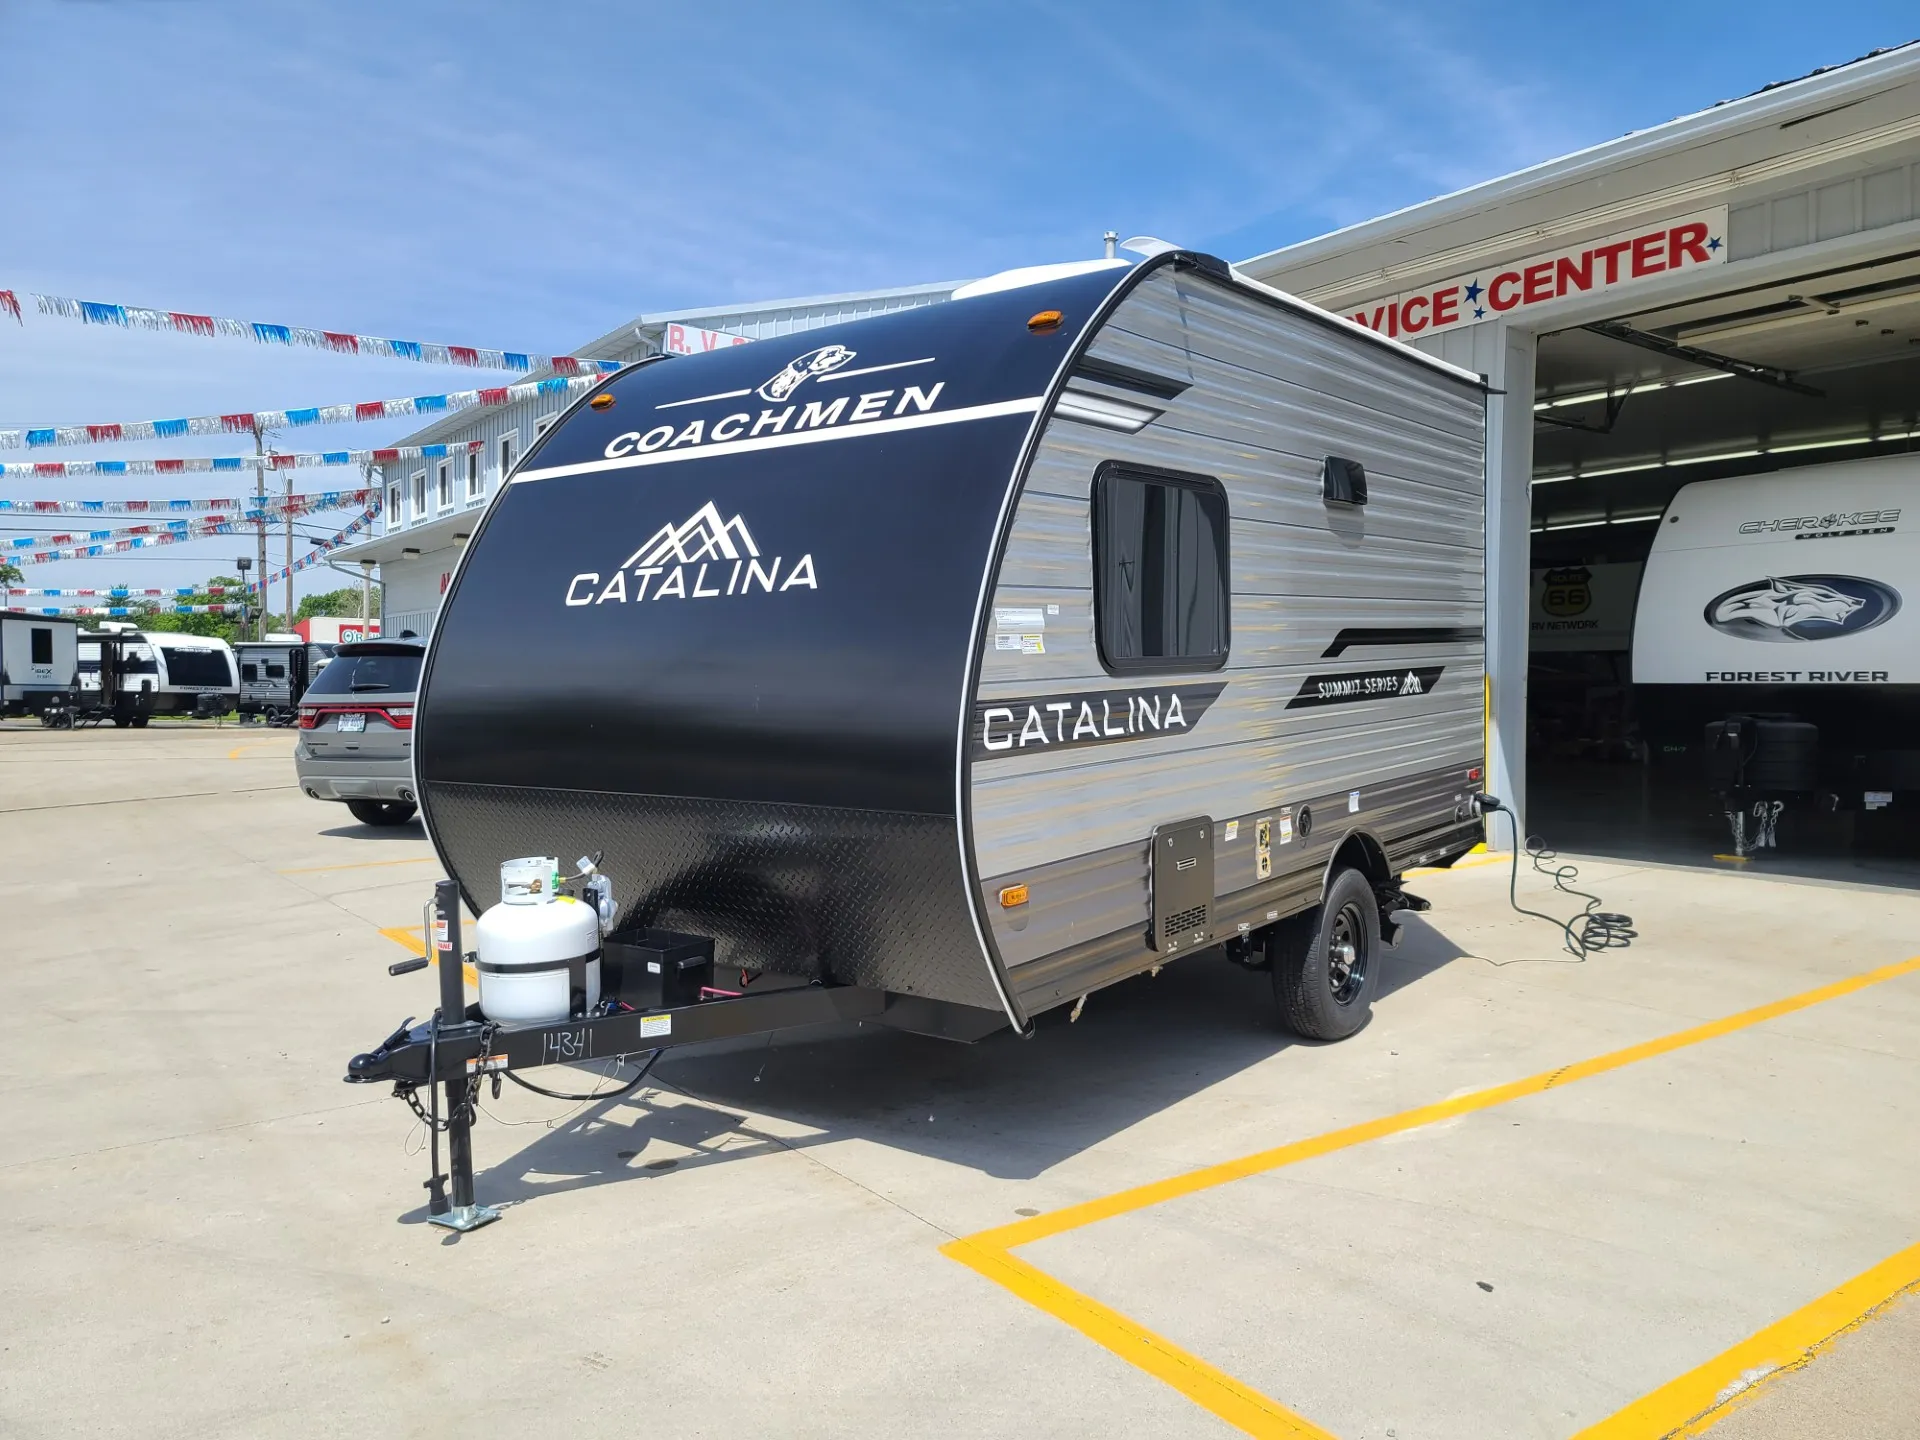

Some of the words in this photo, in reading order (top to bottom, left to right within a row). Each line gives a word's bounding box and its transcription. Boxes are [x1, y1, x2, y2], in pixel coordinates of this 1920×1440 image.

[1346, 286, 1459, 338] VICE
[1488, 221, 1711, 311] CENTER
[603, 382, 945, 458] COACHMEN
[1802, 530, 1844, 539] WOLF
[564, 553, 818, 606] CATALINA
[1549, 588, 1585, 606] 66
[1547, 619, 1600, 630] NETWORK
[1318, 679, 1360, 699] SUMMIT
[1364, 676, 1398, 694] SERIES
[1705, 671, 1802, 682] FOREST
[1808, 671, 1889, 682] RIVER
[983, 693, 1187, 750] CATALINA
[541, 1027, 593, 1067] 14341
